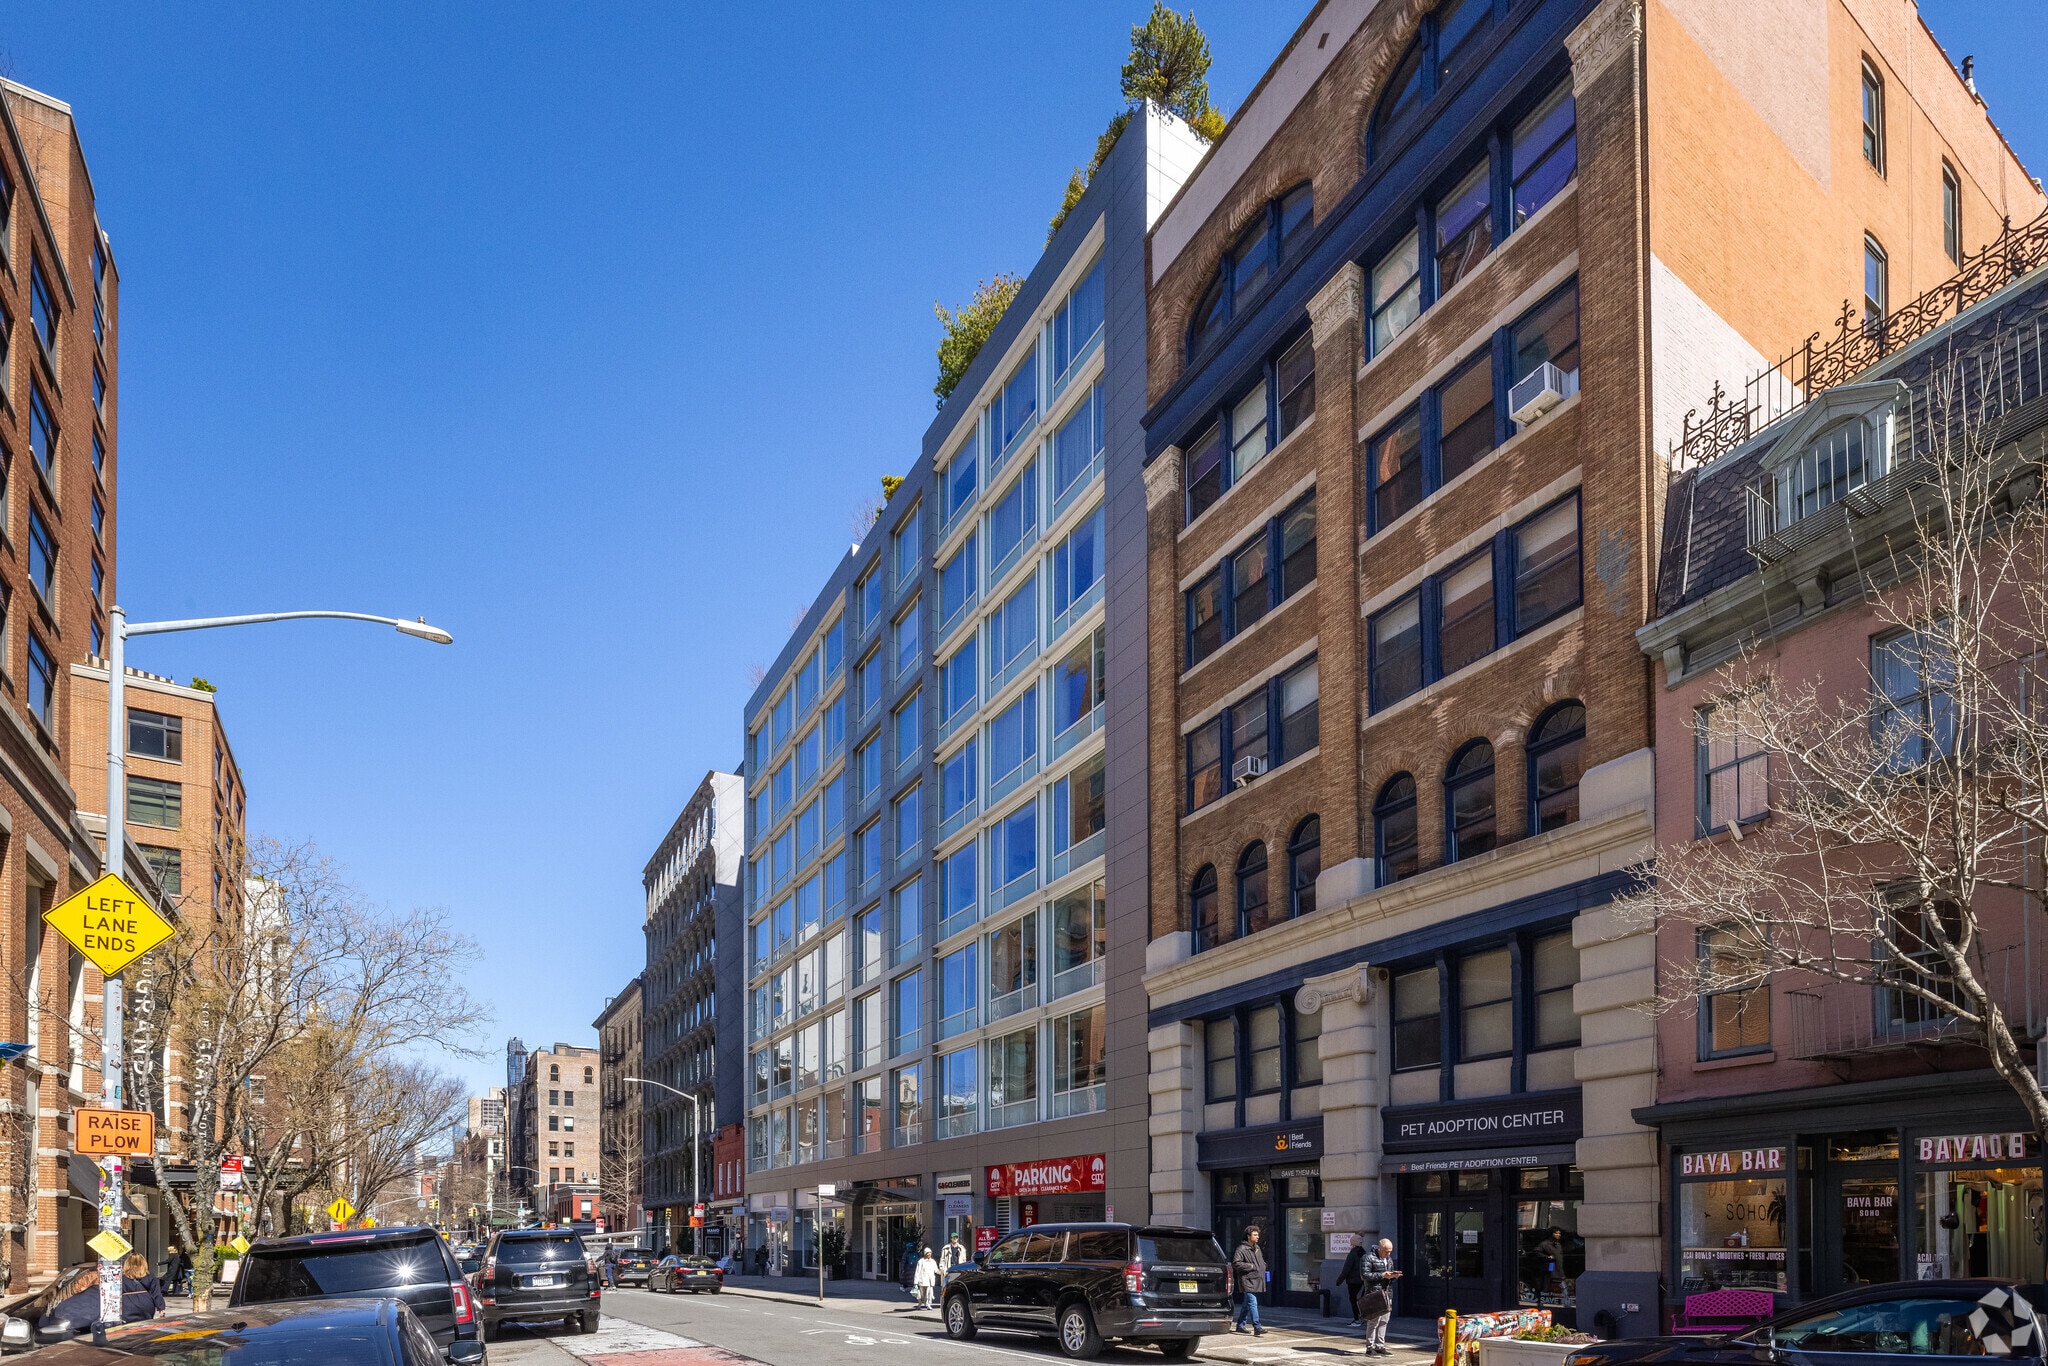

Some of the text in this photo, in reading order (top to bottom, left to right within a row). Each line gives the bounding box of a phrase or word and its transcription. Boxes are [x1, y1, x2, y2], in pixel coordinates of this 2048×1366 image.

[87, 896, 135, 915] LEFT
[83, 915, 138, 934] LANE
[84, 934, 135, 953] ENDS
[133, 979, 155, 1075] GRAND
[88, 1116, 141, 1131] RAISE
[1401, 1110, 1564, 1136] PET ADOPTION CENTER
[91, 1135, 139, 1148] PLOW
[1291, 1133, 1304, 1141] Best
[1291, 1141, 1312, 1149] Friends
[1411, 1156, 1538, 1171] Best Friends PET ADOPTION CENTER
[1683, 1149, 1781, 1175] BAYA BAR
[1015, 1165, 1072, 1186] PARKING
[1091, 1173, 1104, 1181] CITY
[1254, 1183, 1269, 1193] 309
[1847, 1196, 1892, 1208] BAYA BAR
[1726, 1203, 1766, 1220] SOHO
[1683, 1252, 1785, 1260] ACAI BOWLS SMOOTHIES FRESH JUICES
[1917, 1253, 1932, 1263] ACAI
